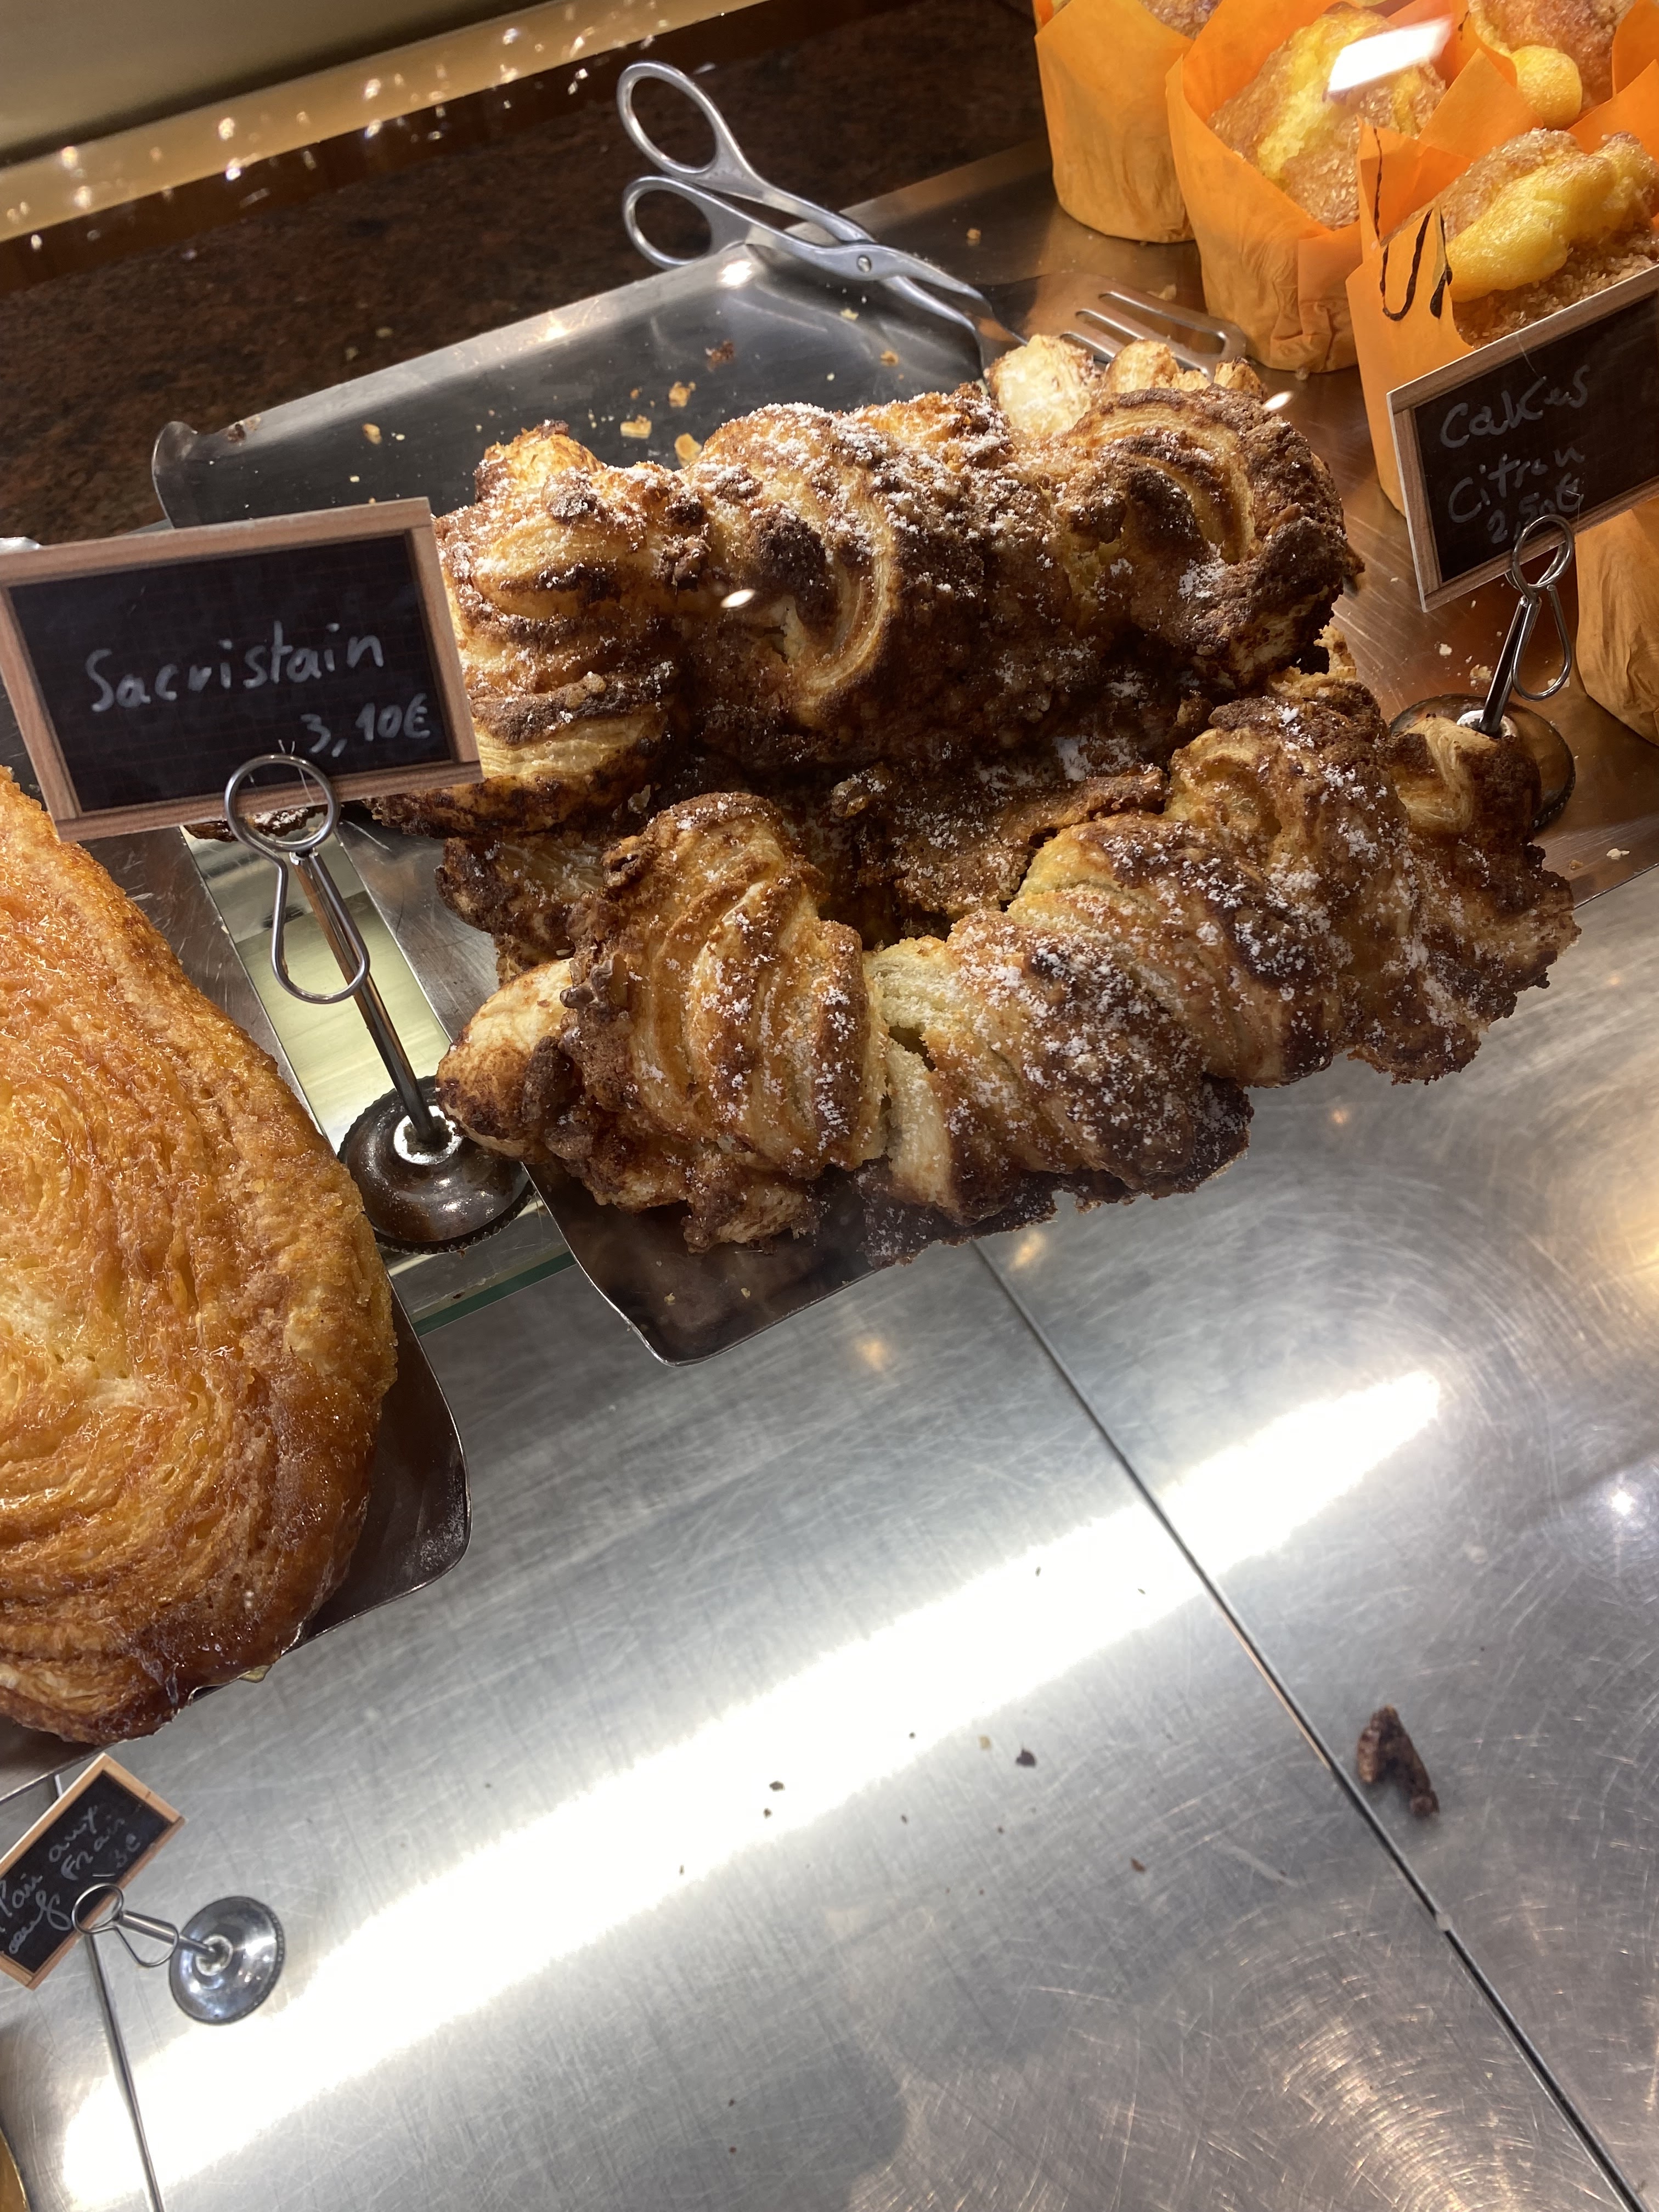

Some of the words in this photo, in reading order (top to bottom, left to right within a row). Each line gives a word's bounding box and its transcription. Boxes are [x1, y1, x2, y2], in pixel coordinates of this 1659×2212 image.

[1439, 364, 1590, 449] Cakes
[1448, 447, 1585, 523] Citron
[86, 620, 385, 713] Sacristain
